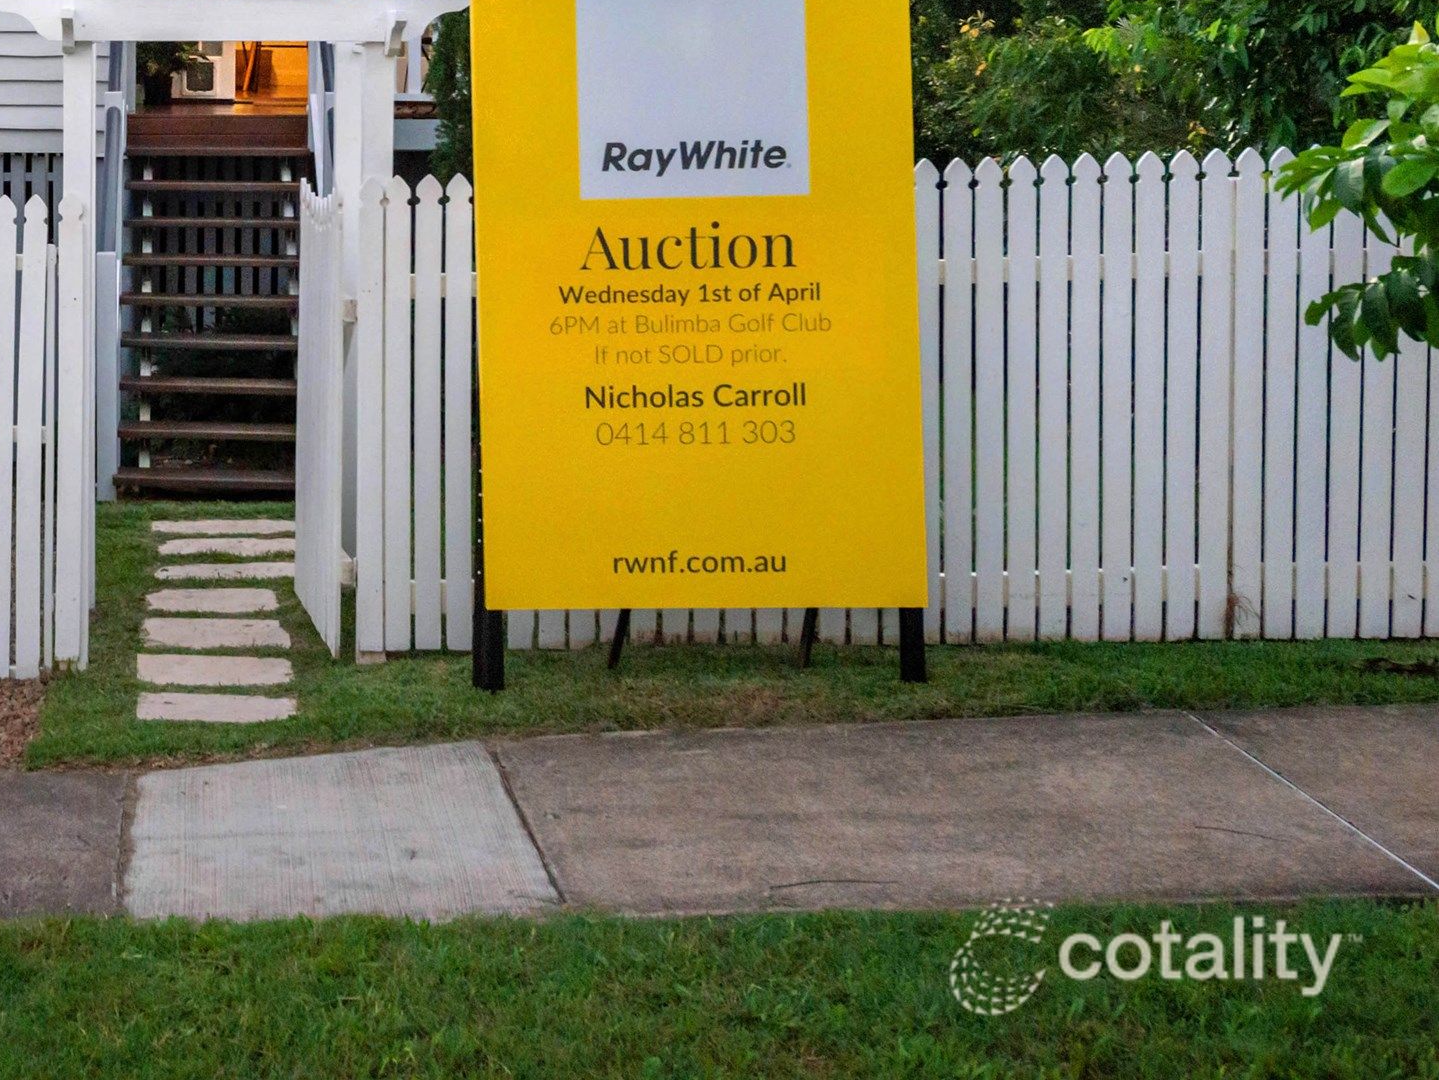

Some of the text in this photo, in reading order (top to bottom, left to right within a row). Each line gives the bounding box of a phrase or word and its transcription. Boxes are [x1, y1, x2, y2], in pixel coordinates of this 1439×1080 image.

[579, 221, 797, 271] Auction
[558, 282, 821, 307] Wednesday 1st of April
[550, 312, 832, 335] 6PM at Bulimba Golf Club
[595, 344, 787, 367] If not SOLD prior.
[585, 382, 806, 409] Nicholas Carroll
[596, 419, 796, 446] 0414 811 303
[613, 550, 786, 574] rwnf.com.au
